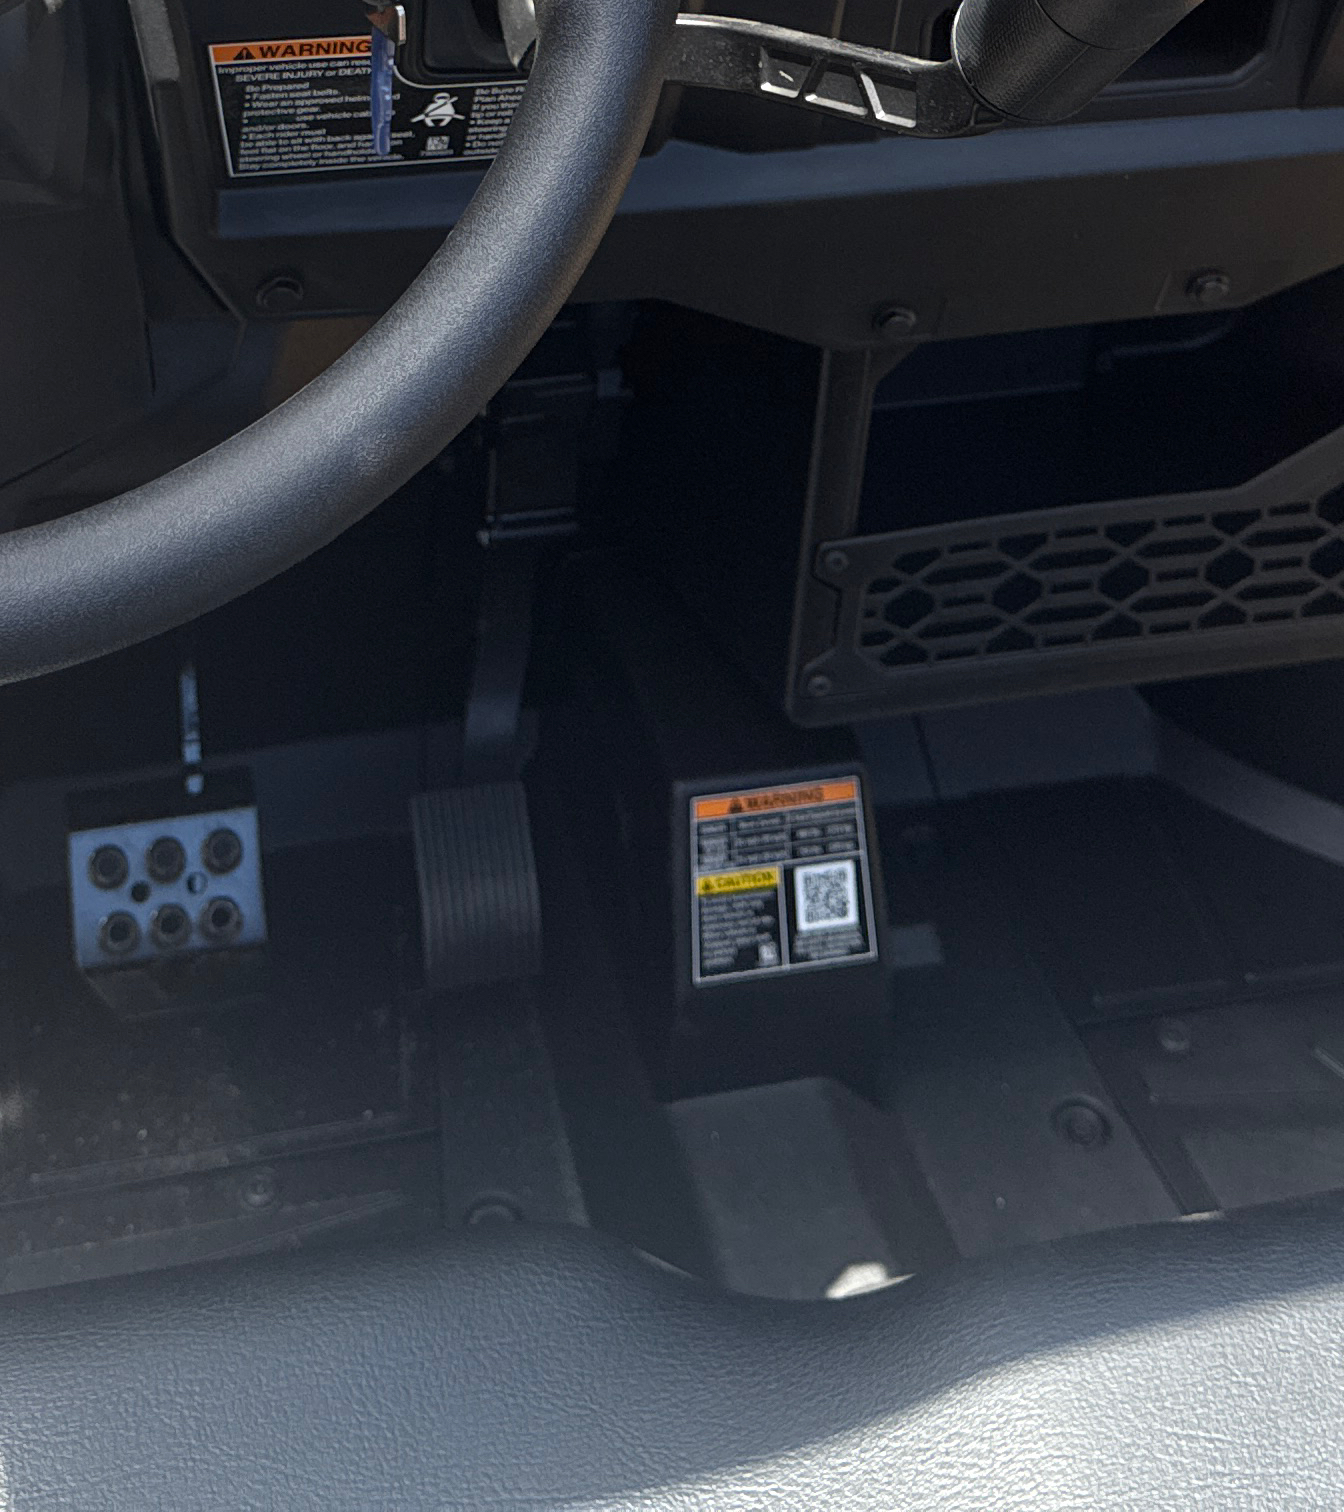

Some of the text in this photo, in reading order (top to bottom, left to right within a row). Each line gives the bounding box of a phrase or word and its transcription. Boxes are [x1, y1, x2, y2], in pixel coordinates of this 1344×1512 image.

[259, 40, 372, 59] WARNING
[218, 64, 270, 75] Improper
[269, 62, 307, 71] vehicle
[308, 61, 329, 69] use
[330, 60, 350, 68] can
[235, 72, 281, 82] SEVERE
[282, 70, 324, 80] INJURY
[325, 69, 337, 77] or
[246, 82, 310, 93] Be Prepared
[252, 92, 288, 101] Fasten
[289, 90, 311, 98] seat
[252, 100, 278, 108] Wear
[295, 96, 344, 107] approved
[242, 106, 295, 117] protective
[316, 111, 352, 120] vehicle
